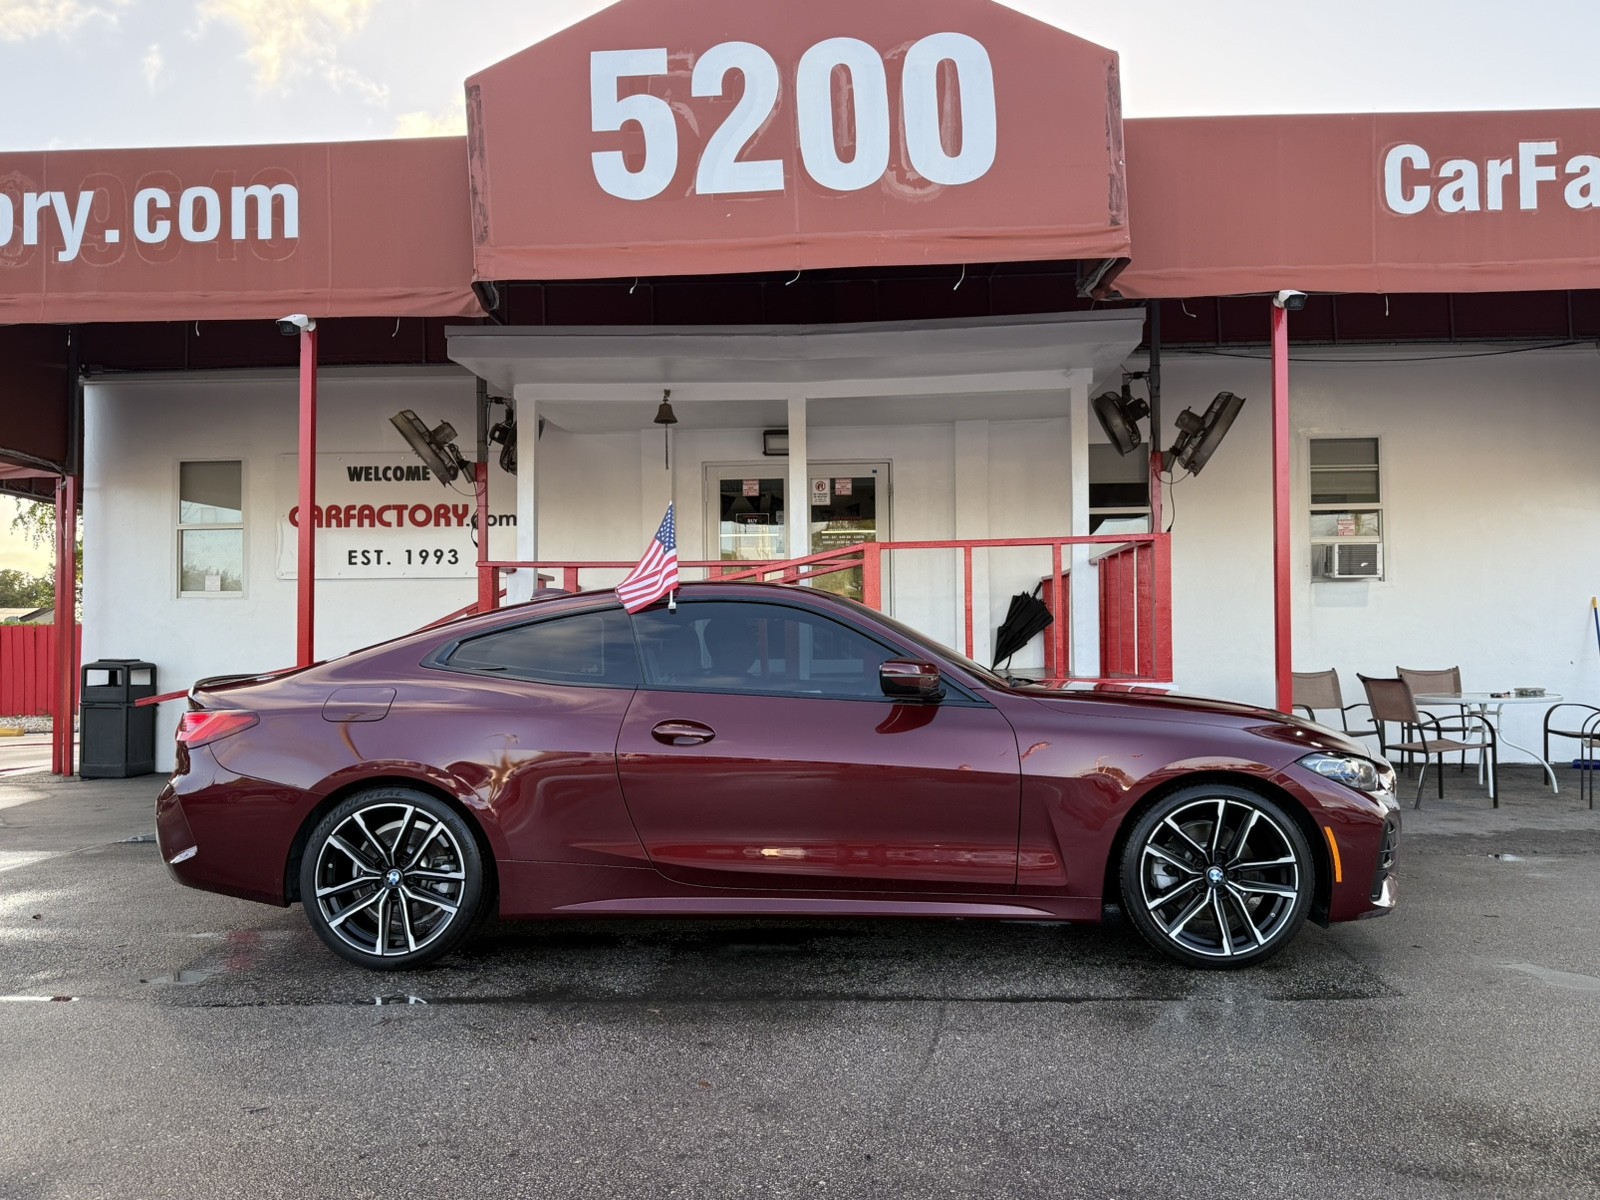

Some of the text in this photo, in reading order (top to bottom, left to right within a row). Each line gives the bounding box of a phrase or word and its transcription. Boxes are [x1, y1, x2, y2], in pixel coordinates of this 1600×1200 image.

[590, 32, 997, 200] 5200
[1384, 141, 1600, 214] CarFa
[347, 465, 431, 482] WELCOME
[347, 548, 459, 566] EST. 1993
